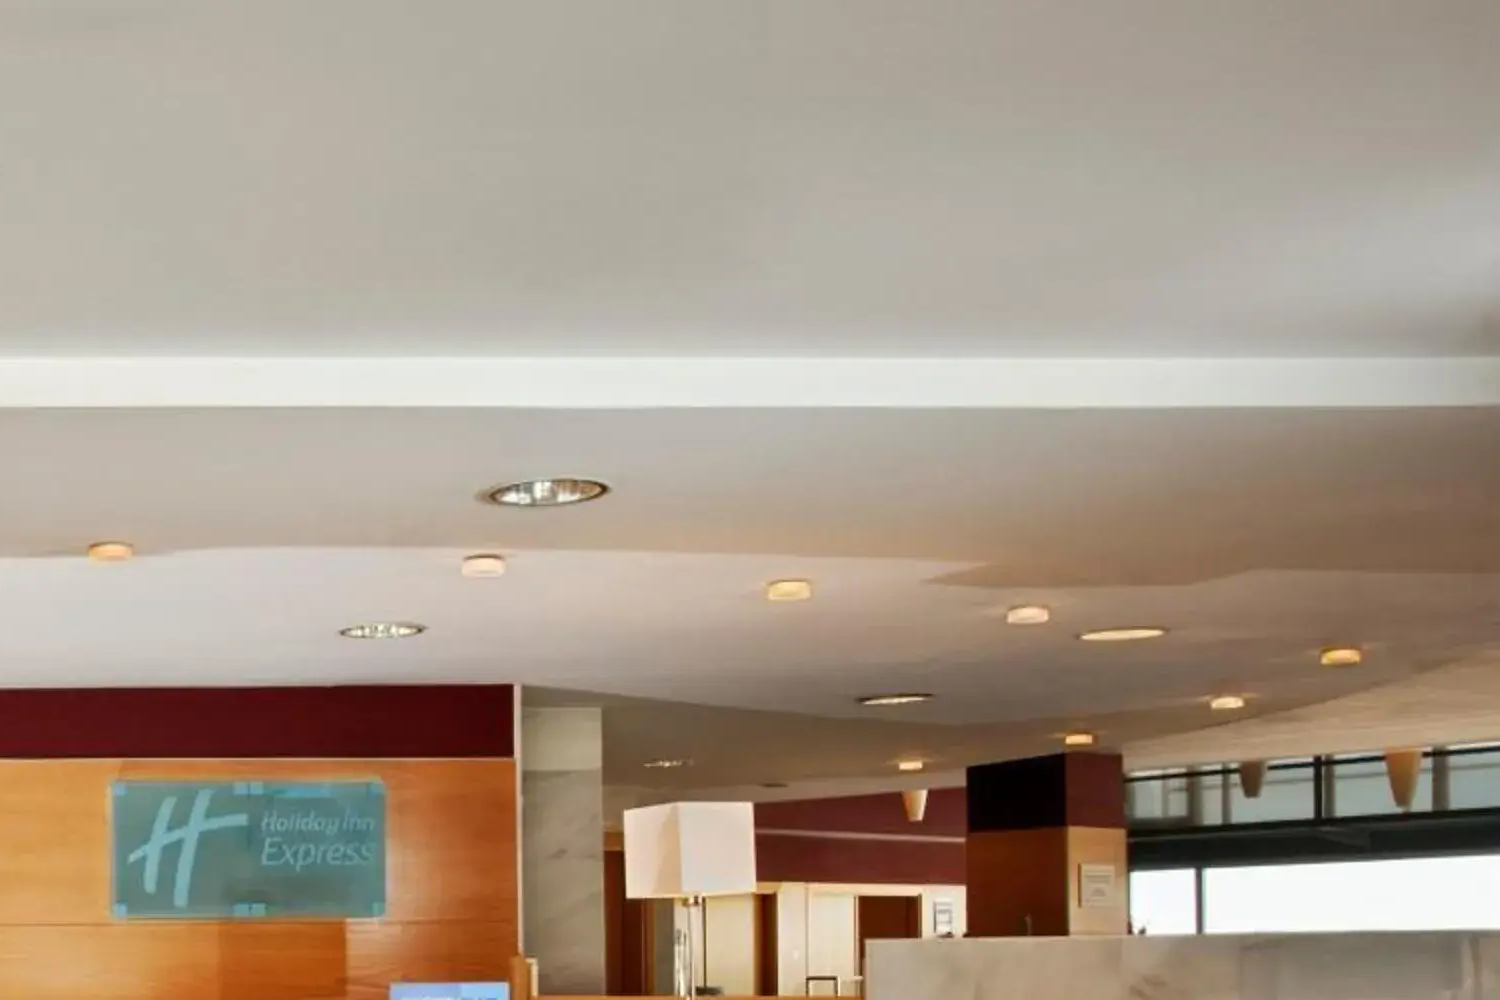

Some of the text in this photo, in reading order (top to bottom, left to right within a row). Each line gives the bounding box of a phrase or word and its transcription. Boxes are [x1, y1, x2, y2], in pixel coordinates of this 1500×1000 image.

[261, 804, 377, 836] Holiday Inn
[261, 837, 375, 873] Express
